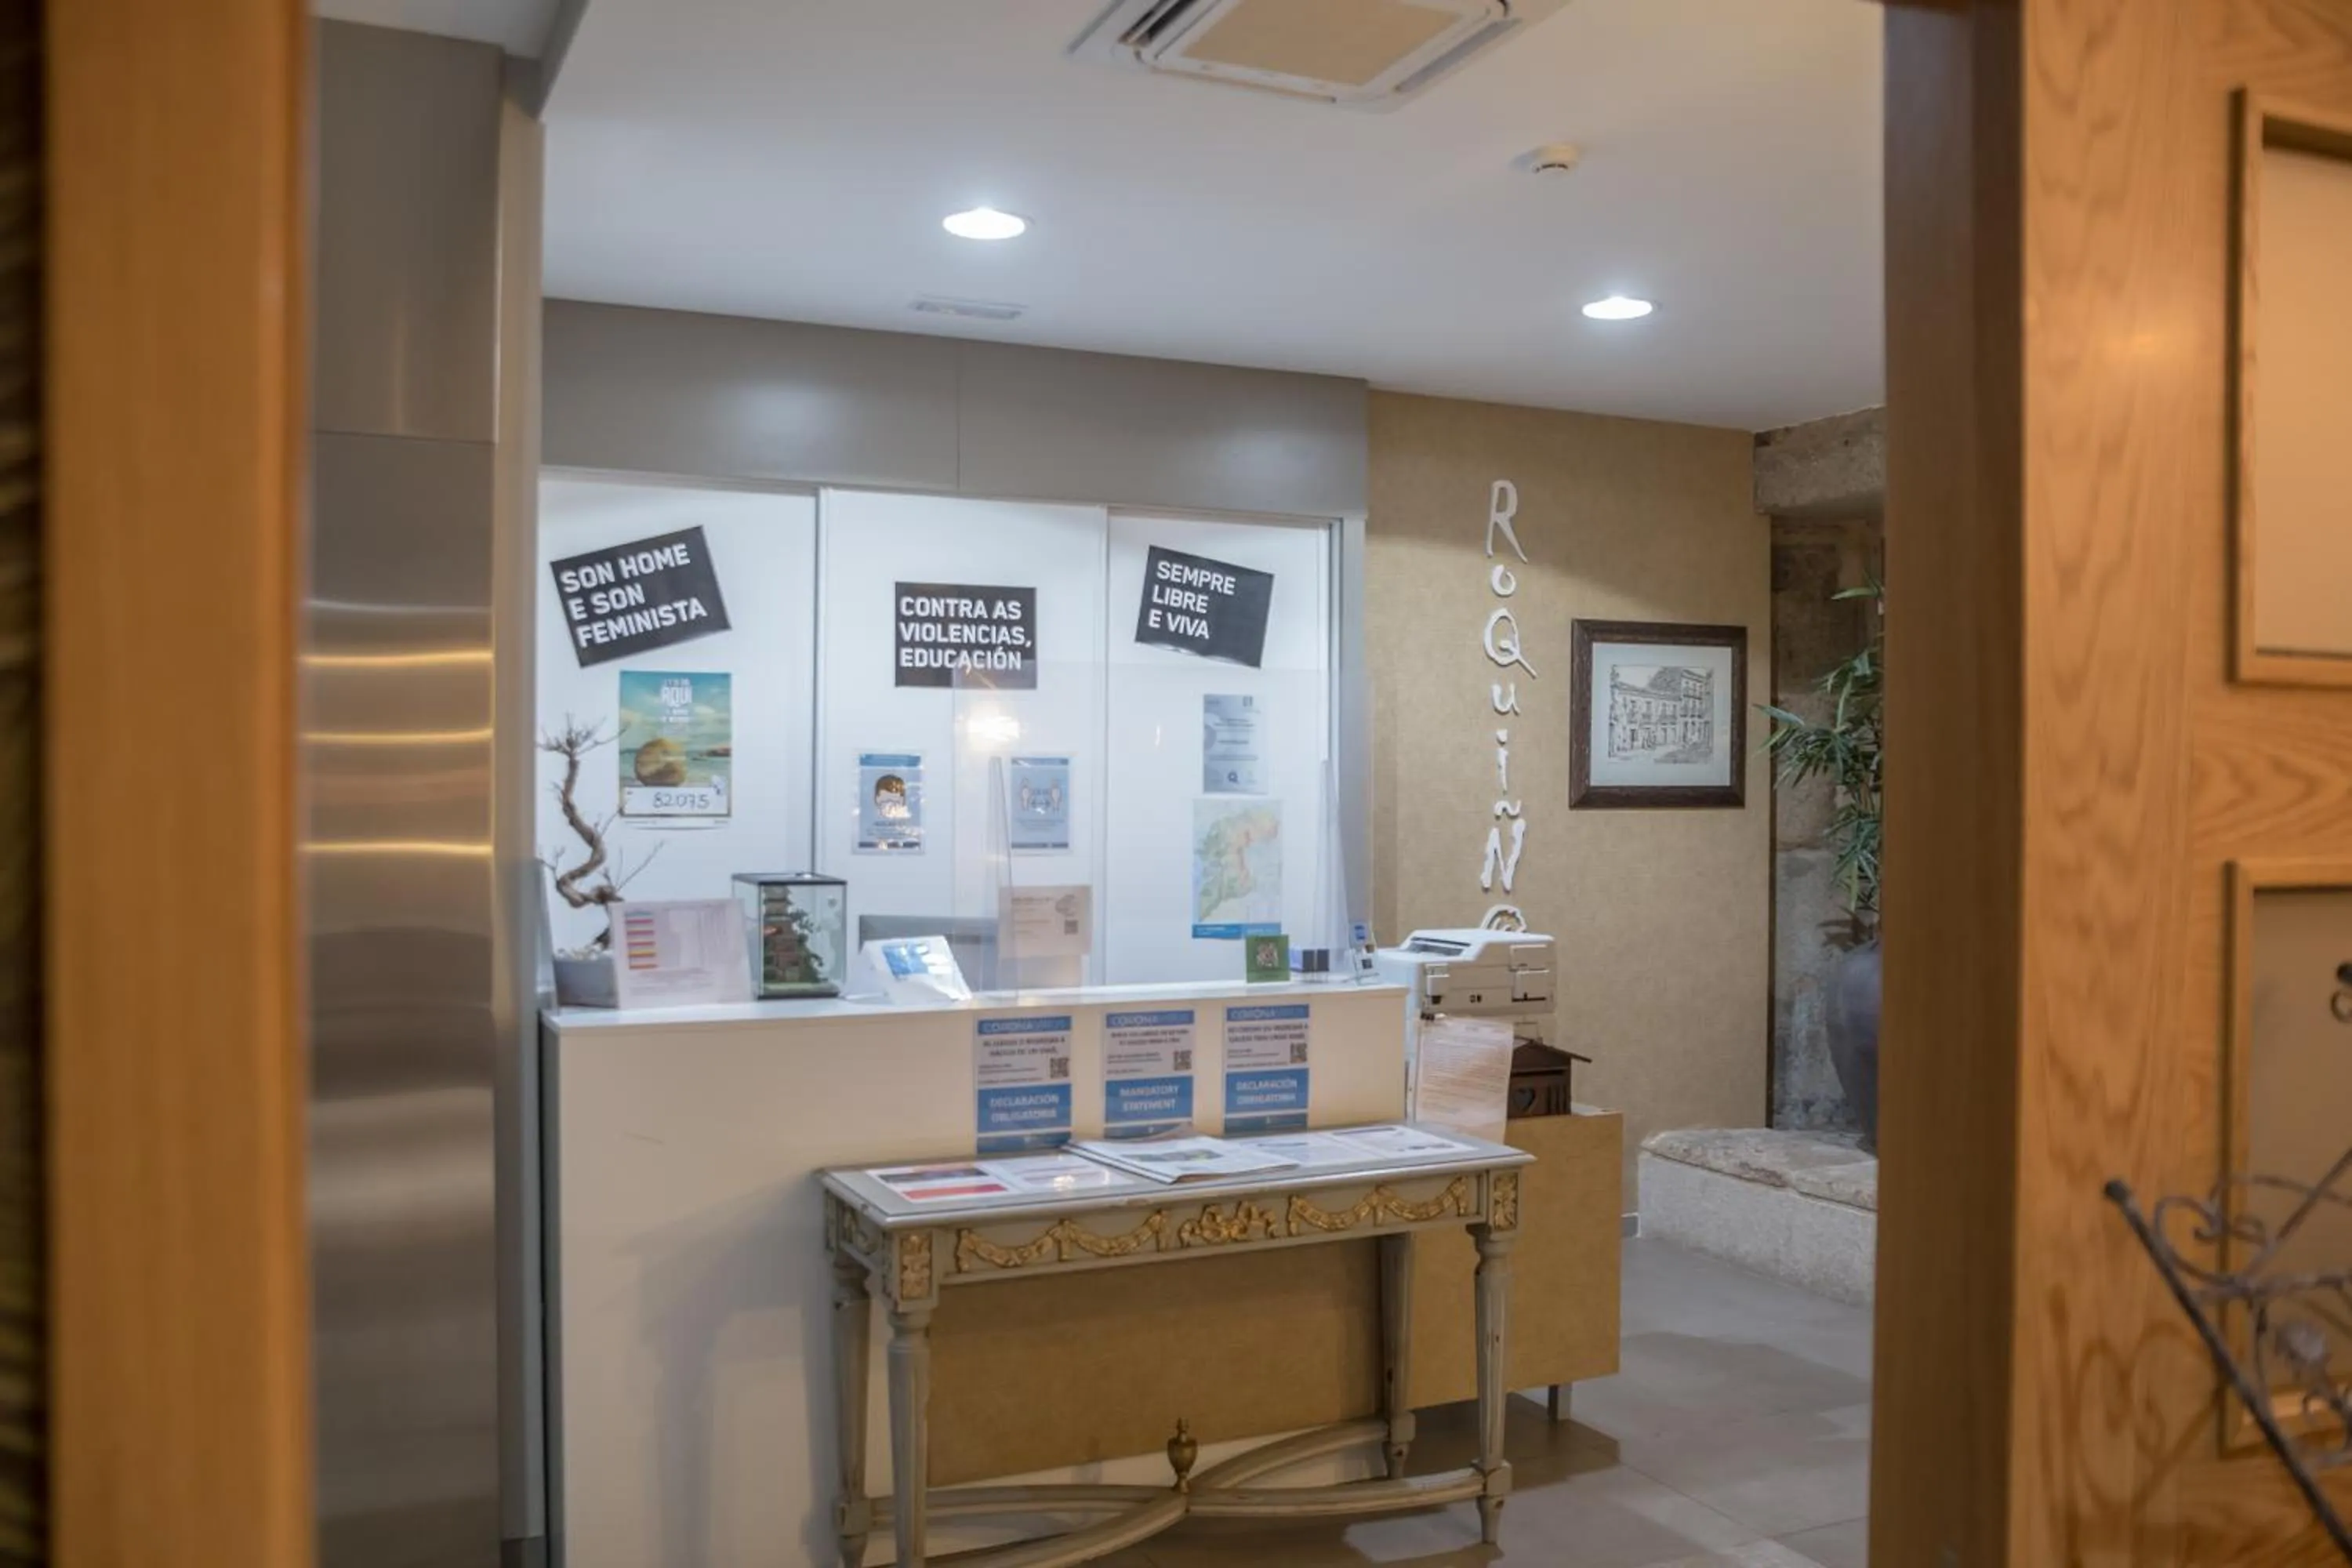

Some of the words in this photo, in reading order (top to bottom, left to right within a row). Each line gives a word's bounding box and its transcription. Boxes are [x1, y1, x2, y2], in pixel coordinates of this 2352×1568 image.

[560, 562, 615, 593] SON
[618, 543, 691, 579] HOME
[1156, 561, 1236, 596] SEMPRE
[568, 598, 587, 620] E
[590, 583, 645, 616] SON
[900, 596, 989, 619] CONTRA
[992, 600, 1022, 620] AS
[1152, 584, 1209, 614] LIBRE
[576, 597, 708, 648] FEMINISTA
[898, 622, 1032, 648] VIOLENCIAS,
[1148, 608, 1163, 629] E
[1167, 612, 1210, 640] VIVA
[899, 646, 1022, 670] EDUCACIÓN
